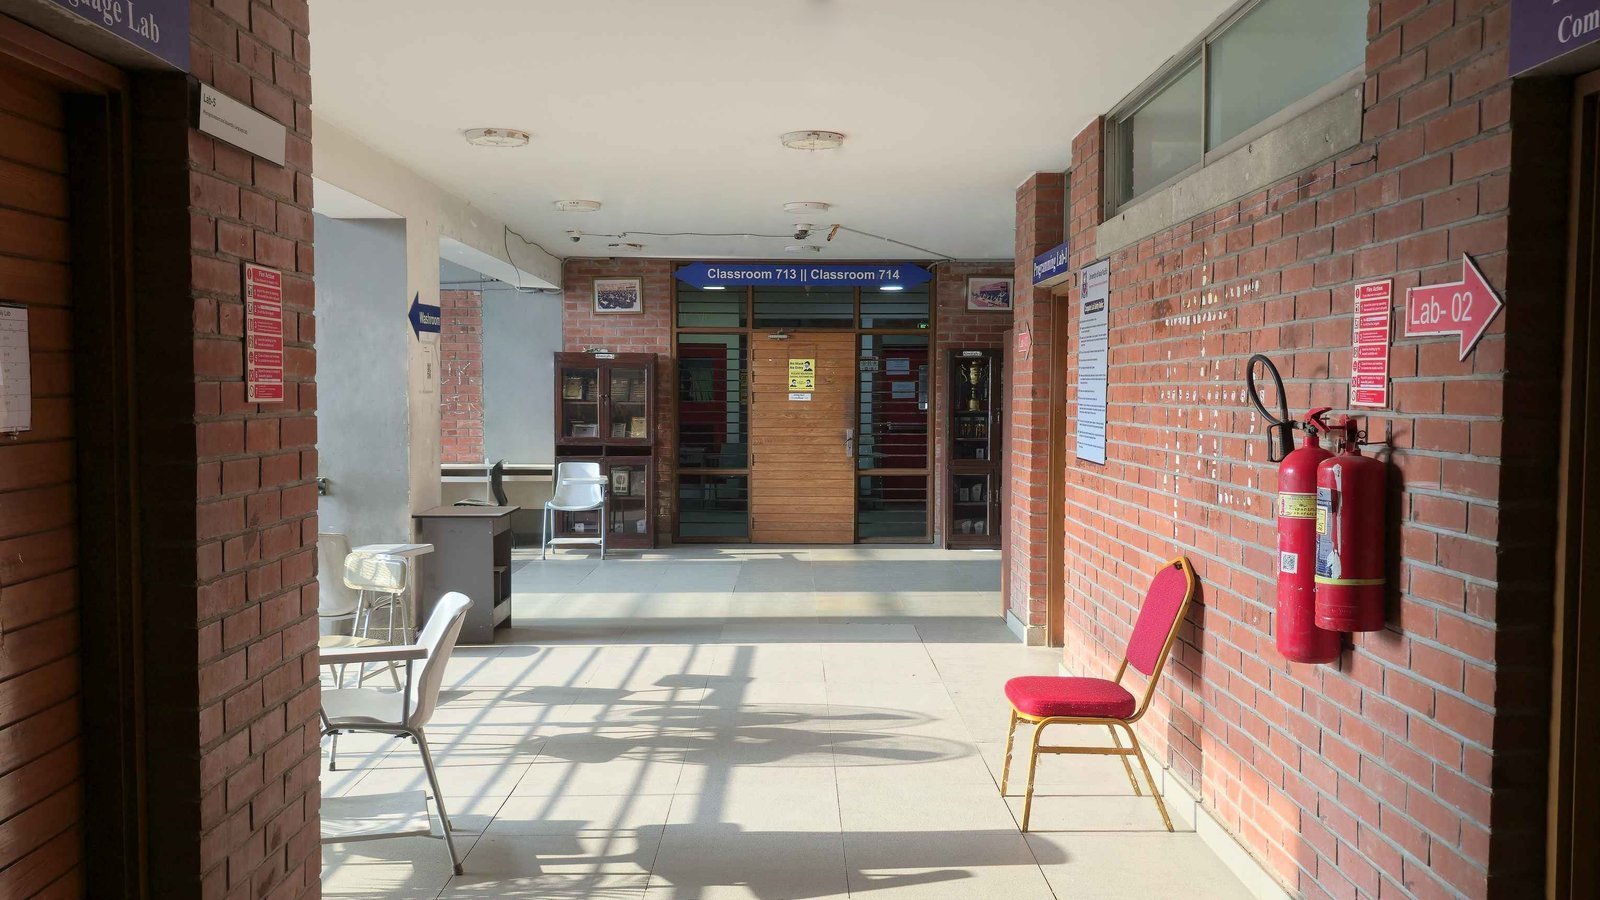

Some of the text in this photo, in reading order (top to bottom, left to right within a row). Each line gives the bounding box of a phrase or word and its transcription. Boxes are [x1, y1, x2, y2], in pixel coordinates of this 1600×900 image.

[128, 0, 159, 43] Lab
[708, 268, 772, 280] Classroom
[776, 268, 797, 280] 713
[811, 268, 875, 280] Classroom
[879, 269, 900, 280] 714
[1411, 291, 1473, 325] Lab- 02
